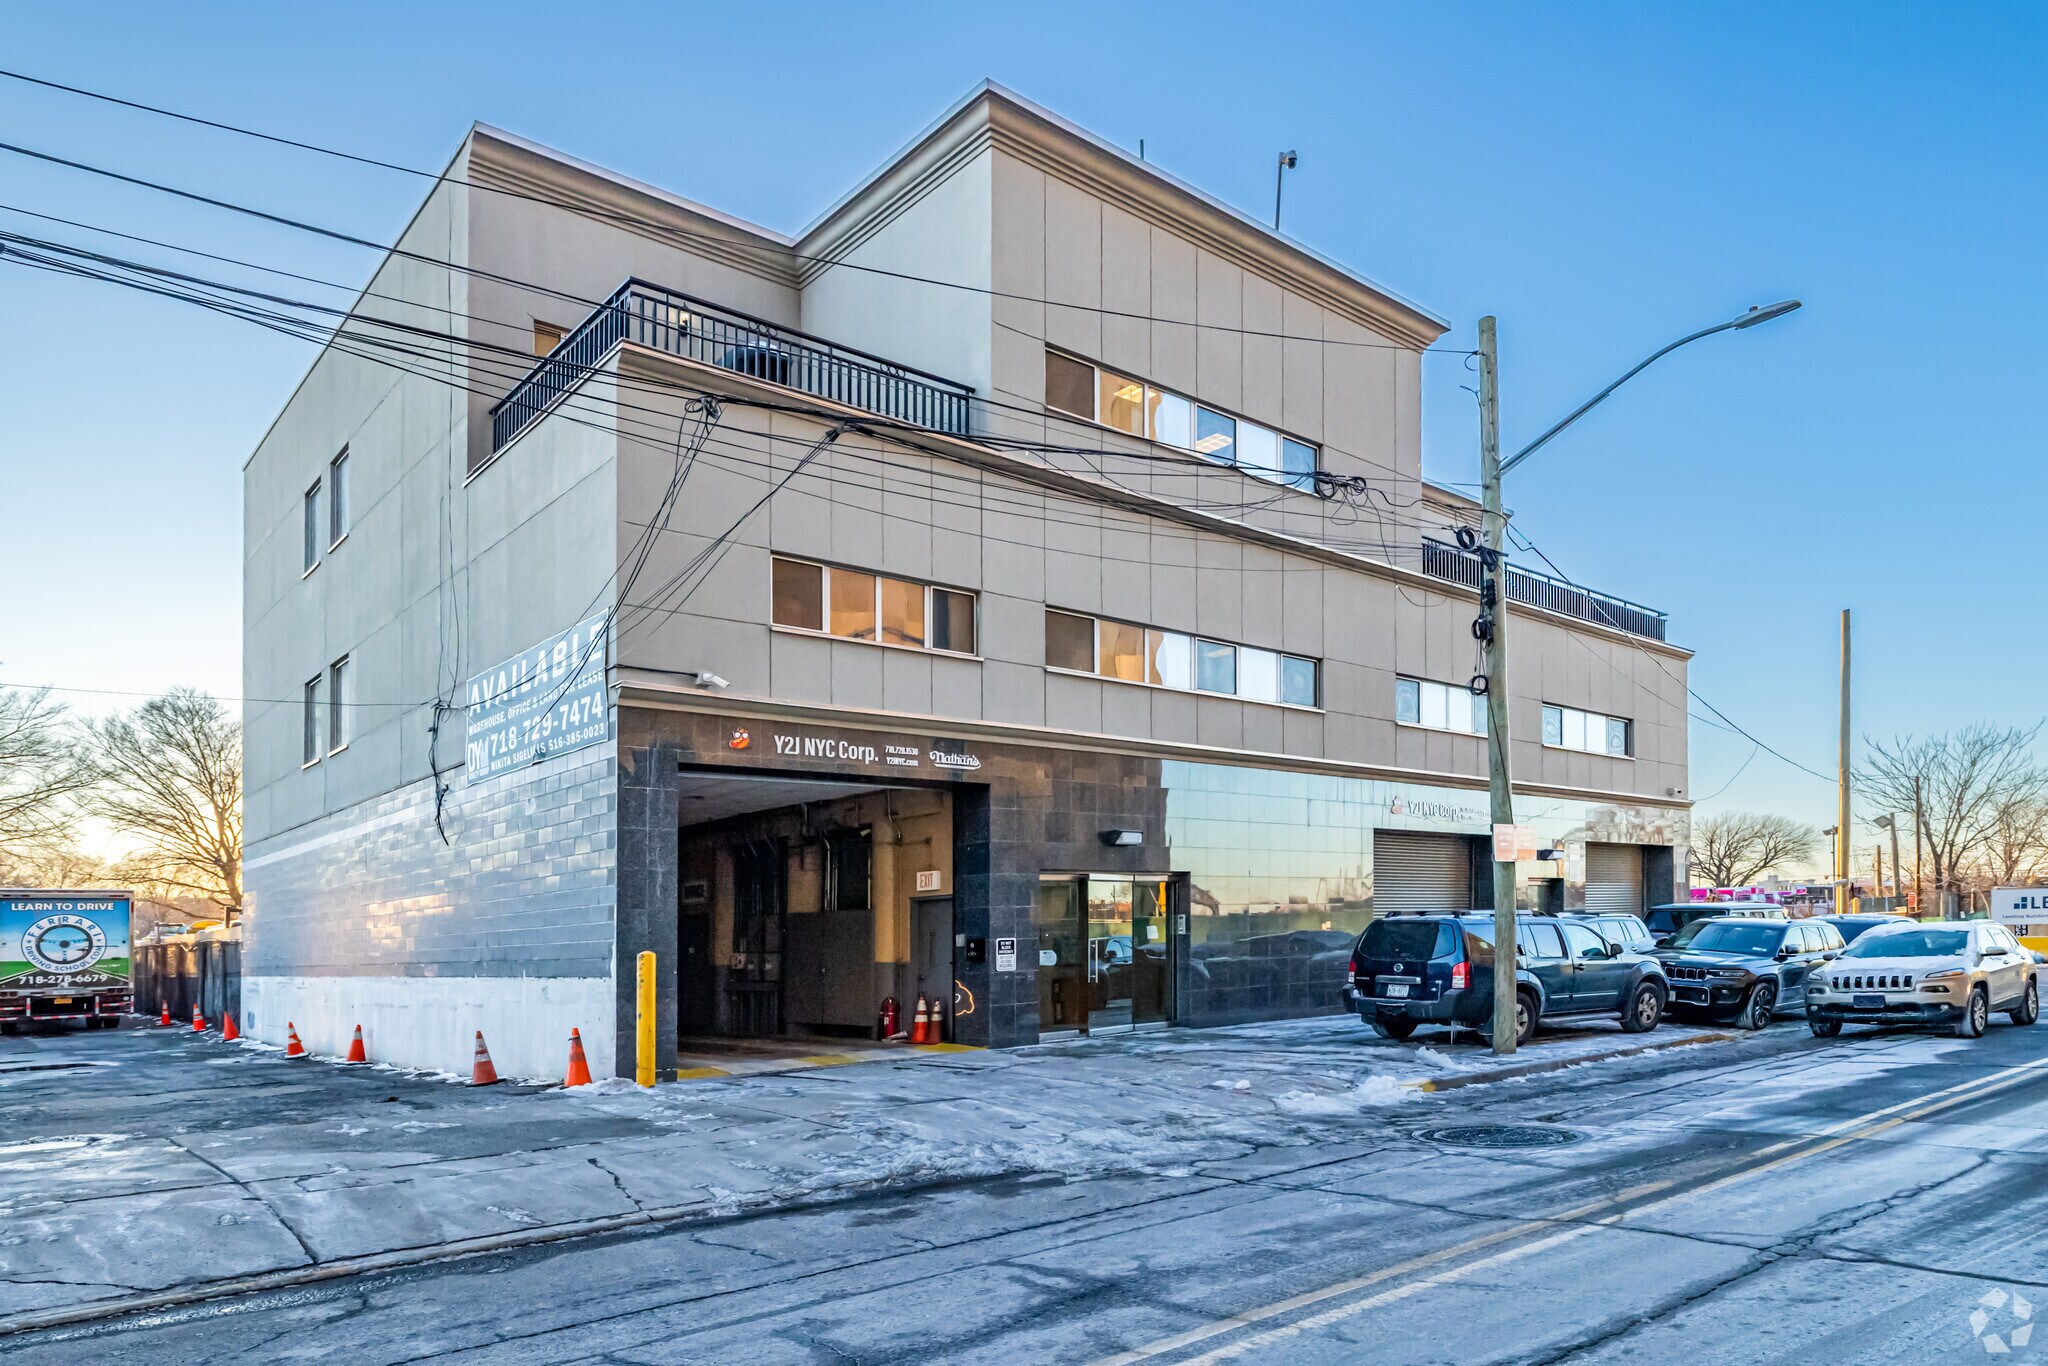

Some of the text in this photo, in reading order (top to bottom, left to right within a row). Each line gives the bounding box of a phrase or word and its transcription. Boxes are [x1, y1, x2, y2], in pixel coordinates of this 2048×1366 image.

[469, 621, 604, 717] AVAILABLE
[468, 671, 603, 736] WAREHOUSE, OFFICE & LAND FOR LEASE
[490, 691, 604, 757] 718-729-7474
[491, 758, 512, 772] NIKITA
[548, 722, 604, 751] 516-385-0023
[804, 738, 835, 757] NYC
[839, 741, 879, 765] Corp.
[929, 750, 981, 767] Nathan's
[1422, 801, 1439, 817] NYC
[1440, 803, 1459, 821] Corp.
[919, 873, 933, 888] EXIT
[11, 903, 114, 911] LEARN TO DRIVE
[28, 916, 102, 938] FERRARI
[25, 946, 52, 970] DRIVING
[19, 975, 107, 985] 718-278-6679
